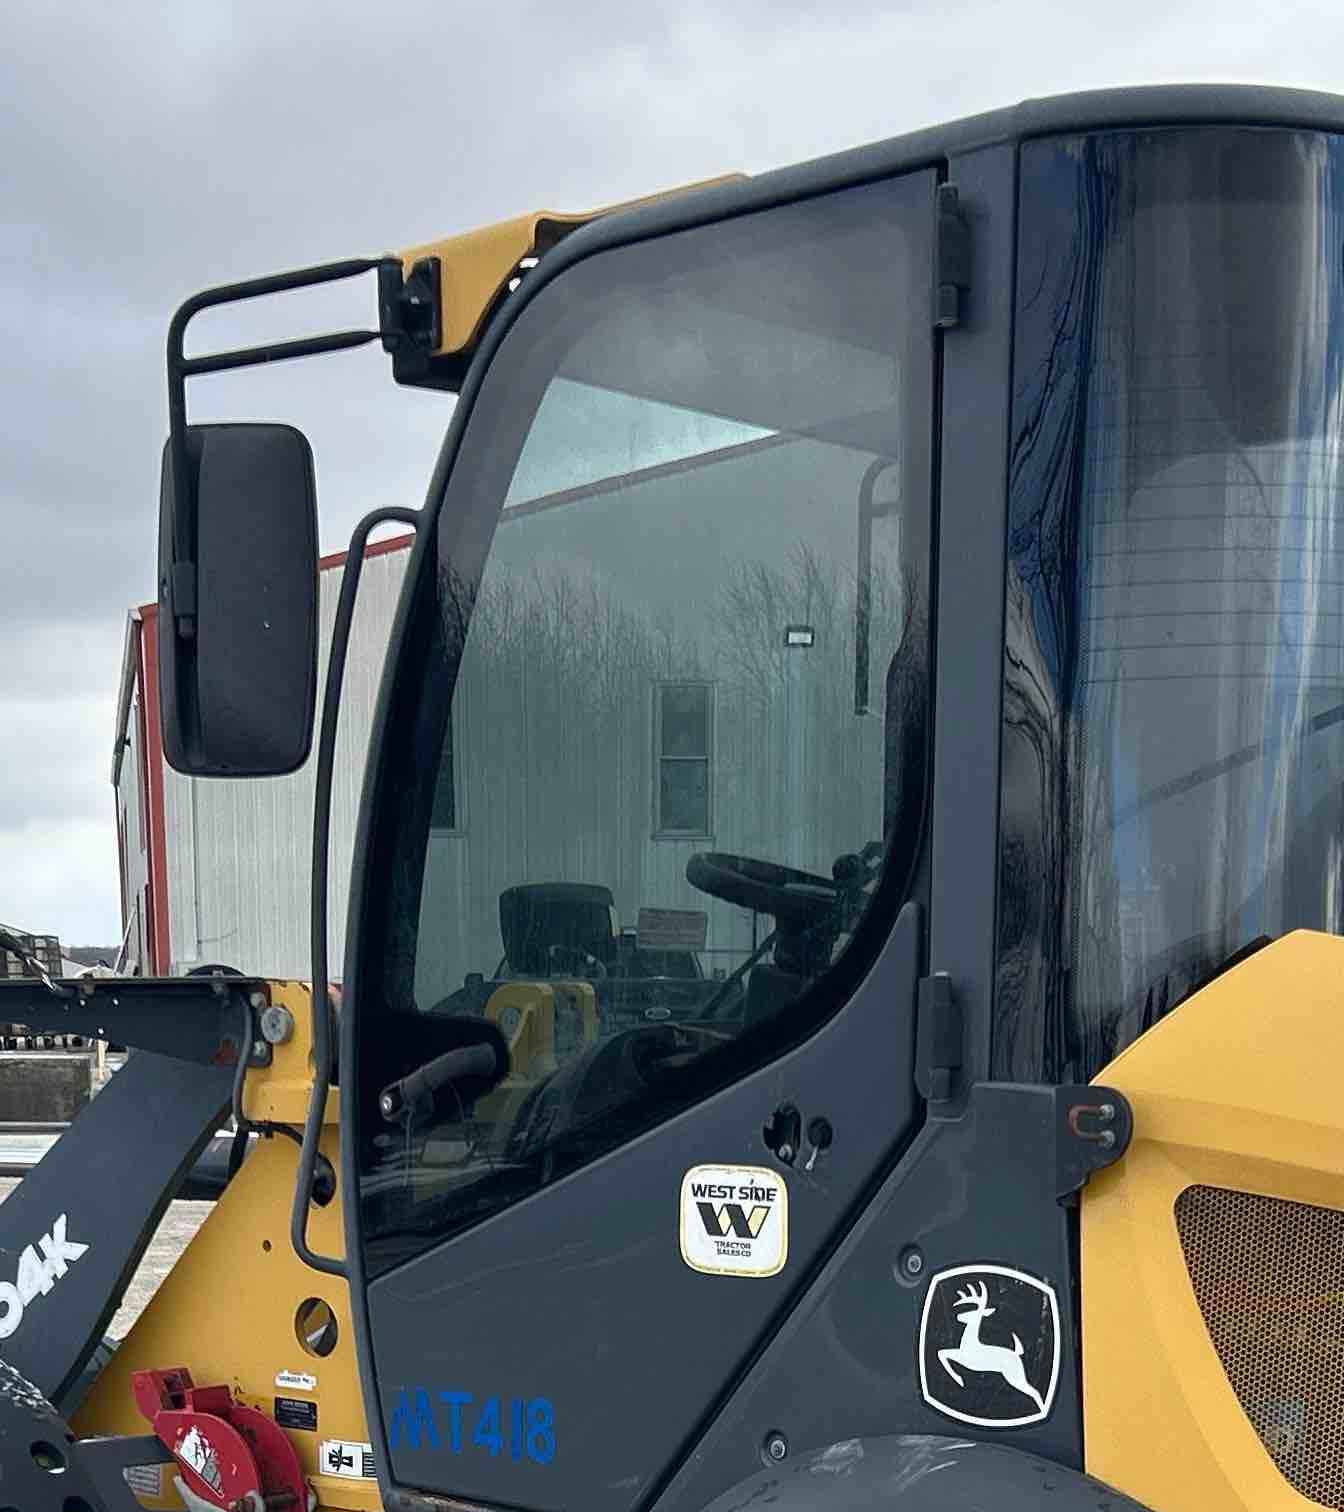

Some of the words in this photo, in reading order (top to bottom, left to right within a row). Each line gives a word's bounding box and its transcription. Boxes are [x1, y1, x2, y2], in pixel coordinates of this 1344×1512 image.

[691, 1184, 736, 1198] WEST
[739, 1186, 777, 1201] SIDE
[714, 1241, 751, 1249] TRACTOR
[390, 1388, 555, 1464] MT418
